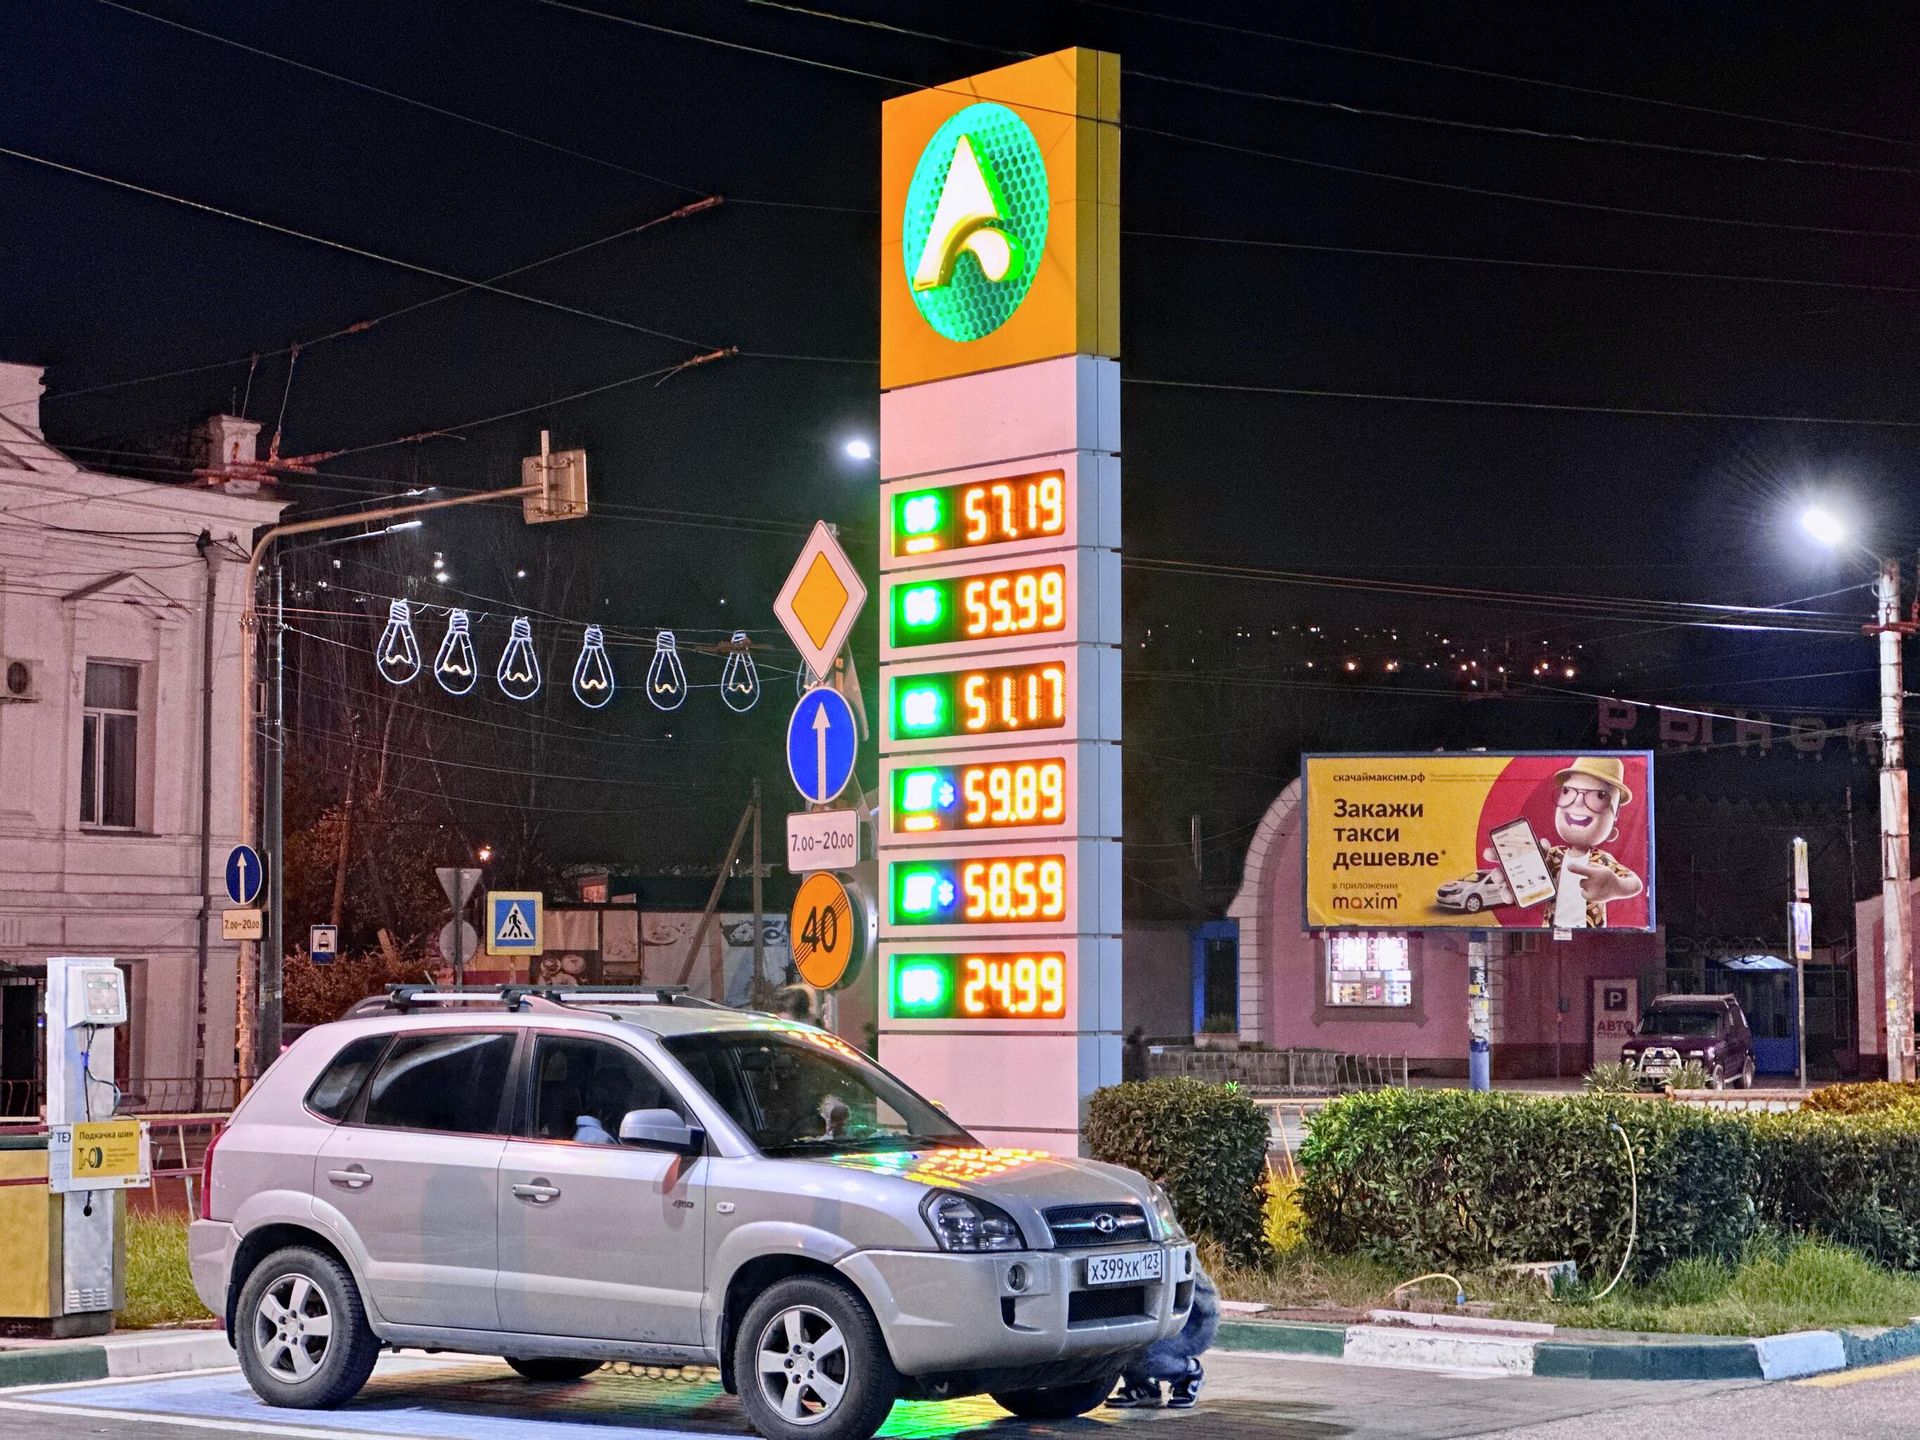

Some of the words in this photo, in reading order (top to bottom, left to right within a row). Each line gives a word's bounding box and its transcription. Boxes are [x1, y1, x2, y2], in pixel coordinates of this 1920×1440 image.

[1333, 772, 1426, 783] скачаймаксим.рф
[1333, 798, 1424, 818] Закажи
[1333, 827, 1400, 842] такси
[1340, 882, 1398, 890] приложении
[1332, 892, 1397, 909] maxim
[801, 905, 837, 953] 40
[79, 1131, 116, 1141] Подкачка
[117, 1131, 134, 1139] шин
[1142, 1253, 1159, 1270] 123
